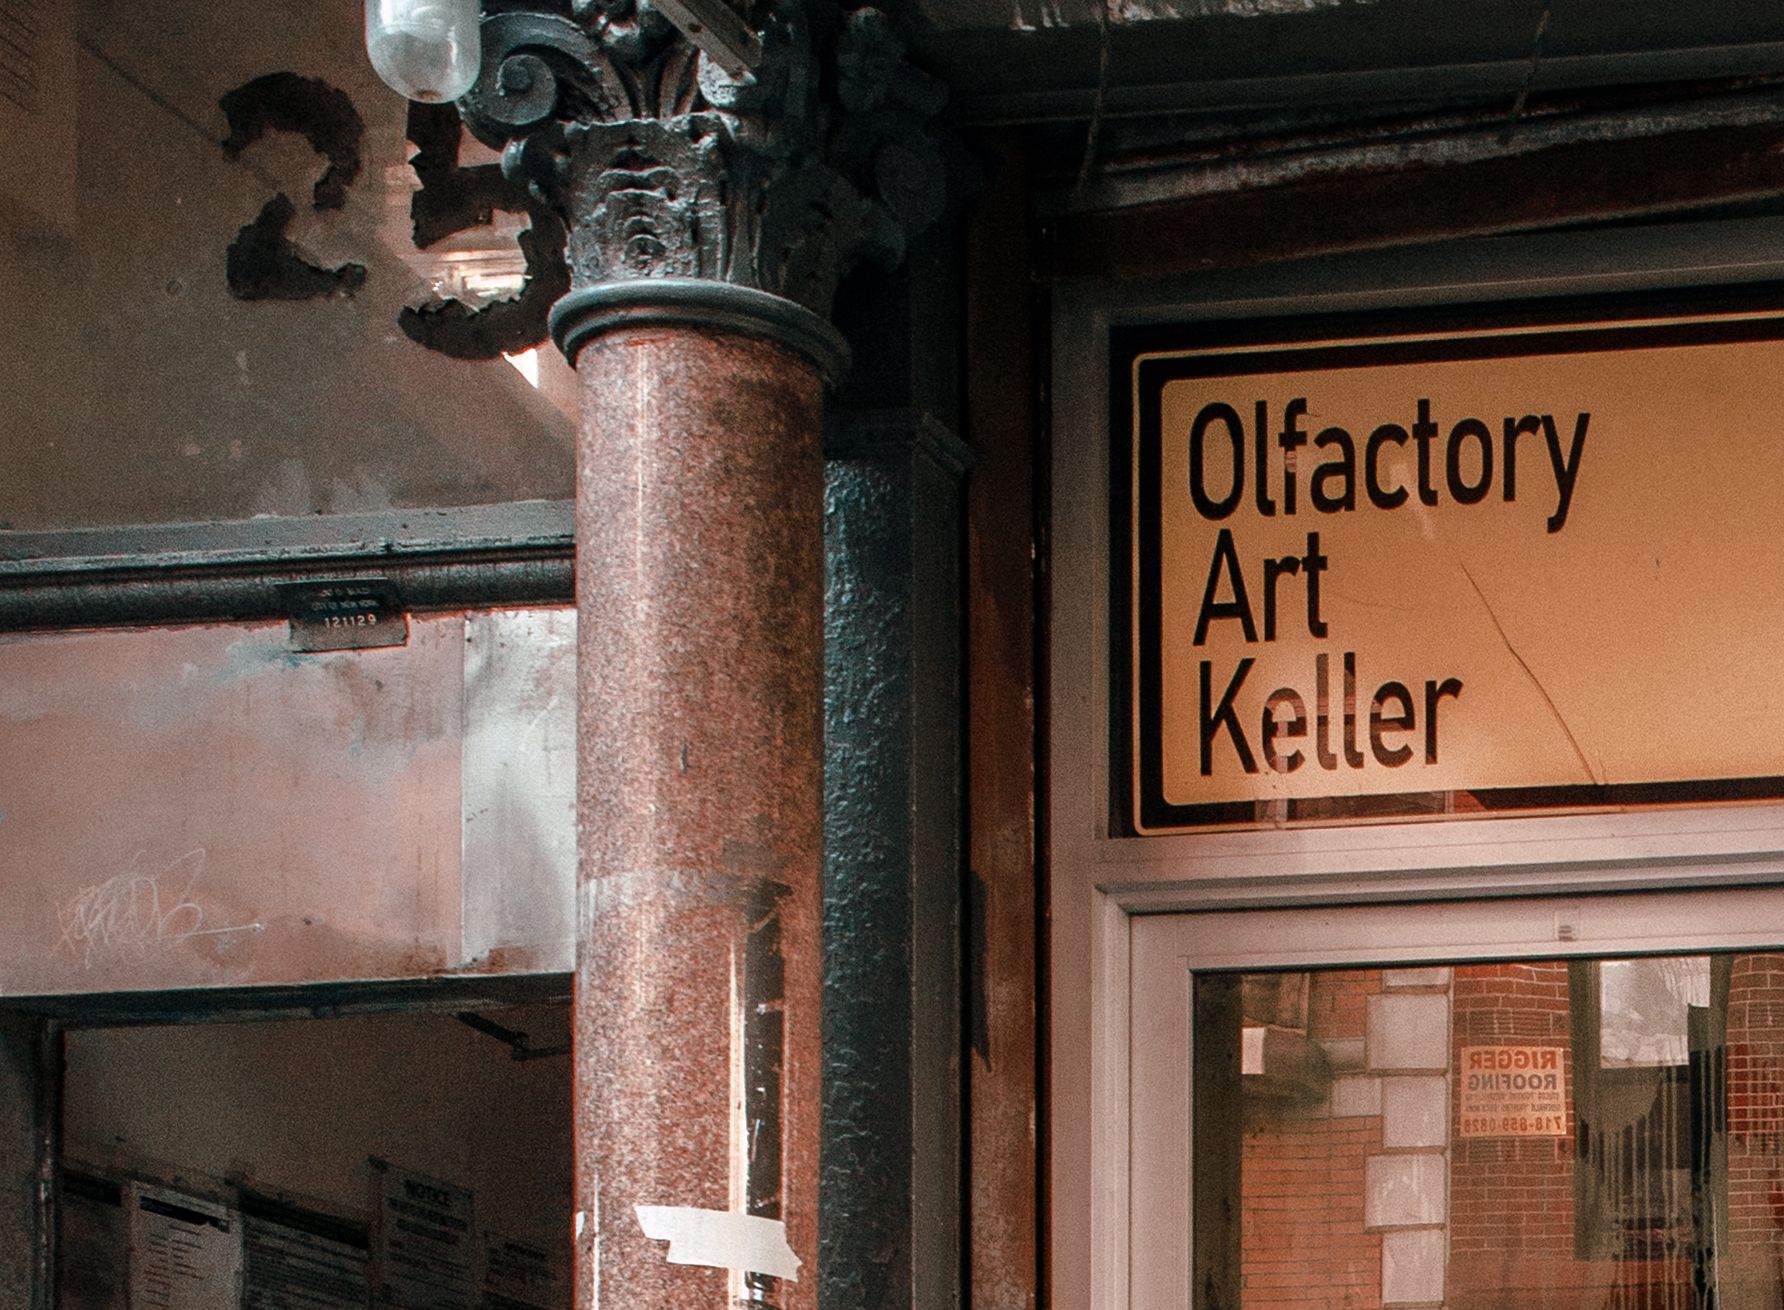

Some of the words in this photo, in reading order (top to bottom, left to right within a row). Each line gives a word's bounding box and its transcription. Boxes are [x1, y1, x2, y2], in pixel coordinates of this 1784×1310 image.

[1189, 396, 1591, 534] Olfactory
[324, 613, 377, 629] 121129
[1192, 528, 1329, 647] Art
[1199, 651, 1464, 776] Keller
